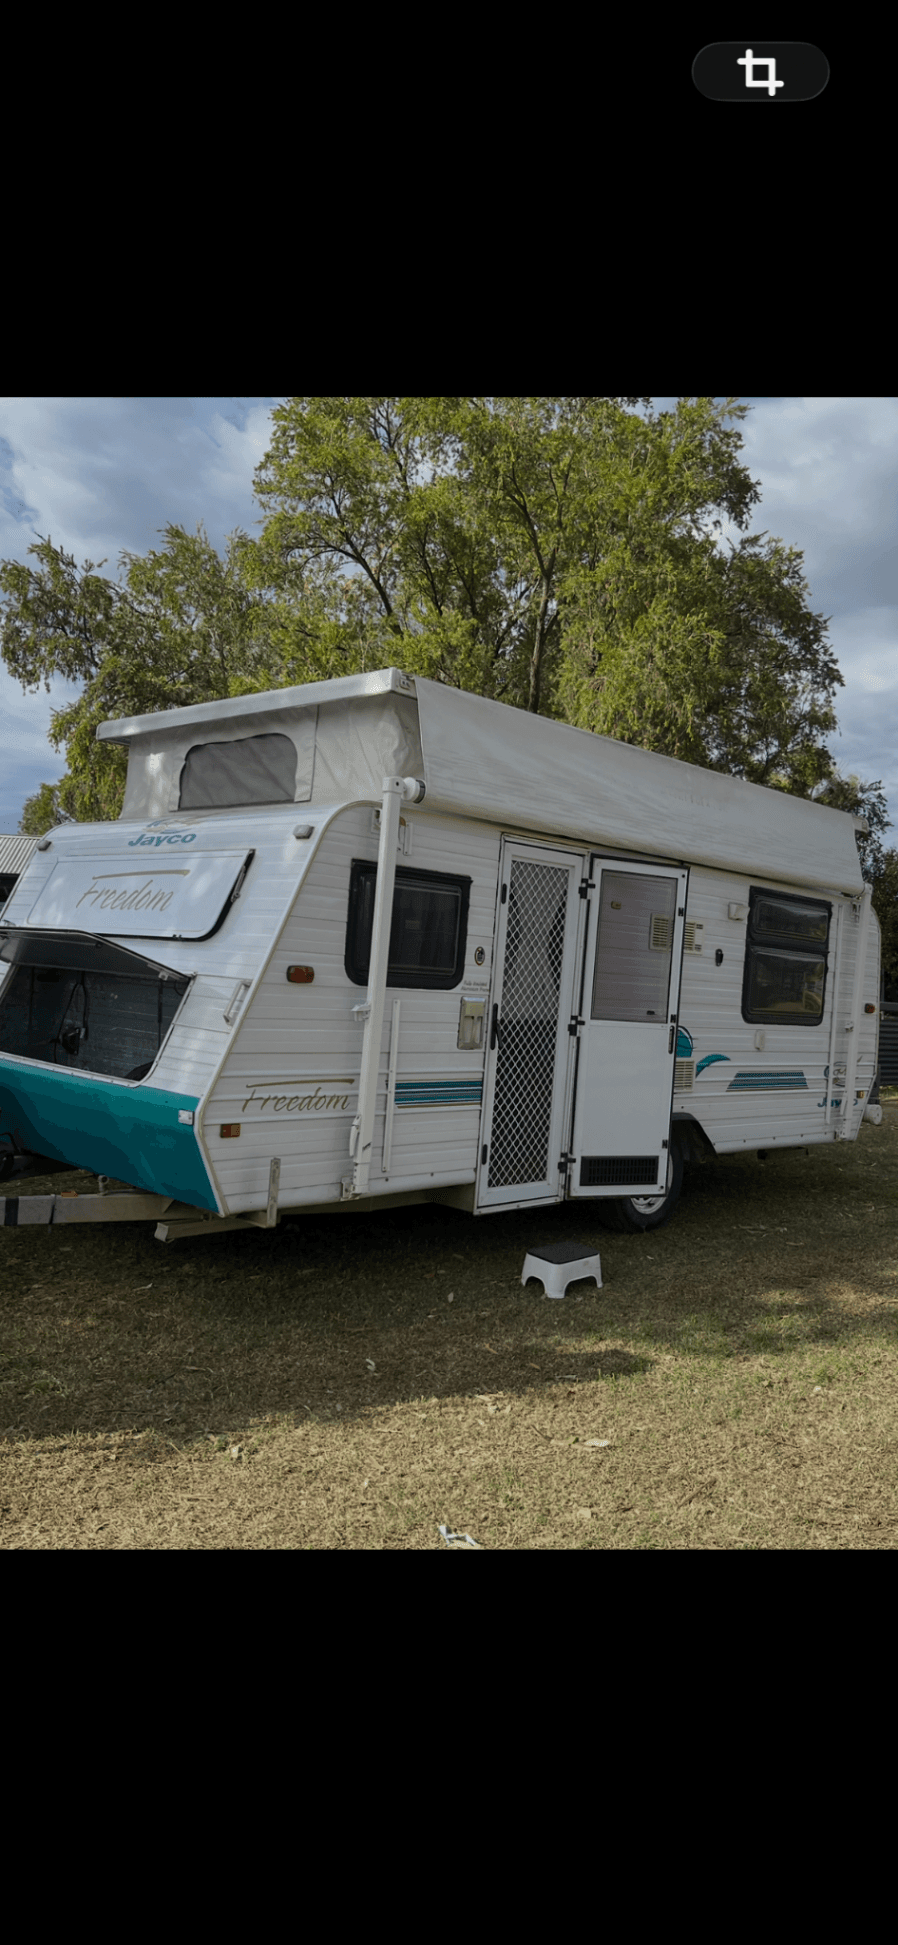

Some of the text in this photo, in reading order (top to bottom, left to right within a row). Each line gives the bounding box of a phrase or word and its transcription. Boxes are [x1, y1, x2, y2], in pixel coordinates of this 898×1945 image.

[127, 833, 197, 847] Jayco
[75, 869, 191, 912] Freedom
[241, 1078, 355, 1113] Freedom
[817, 1097, 859, 1108] Jayo
